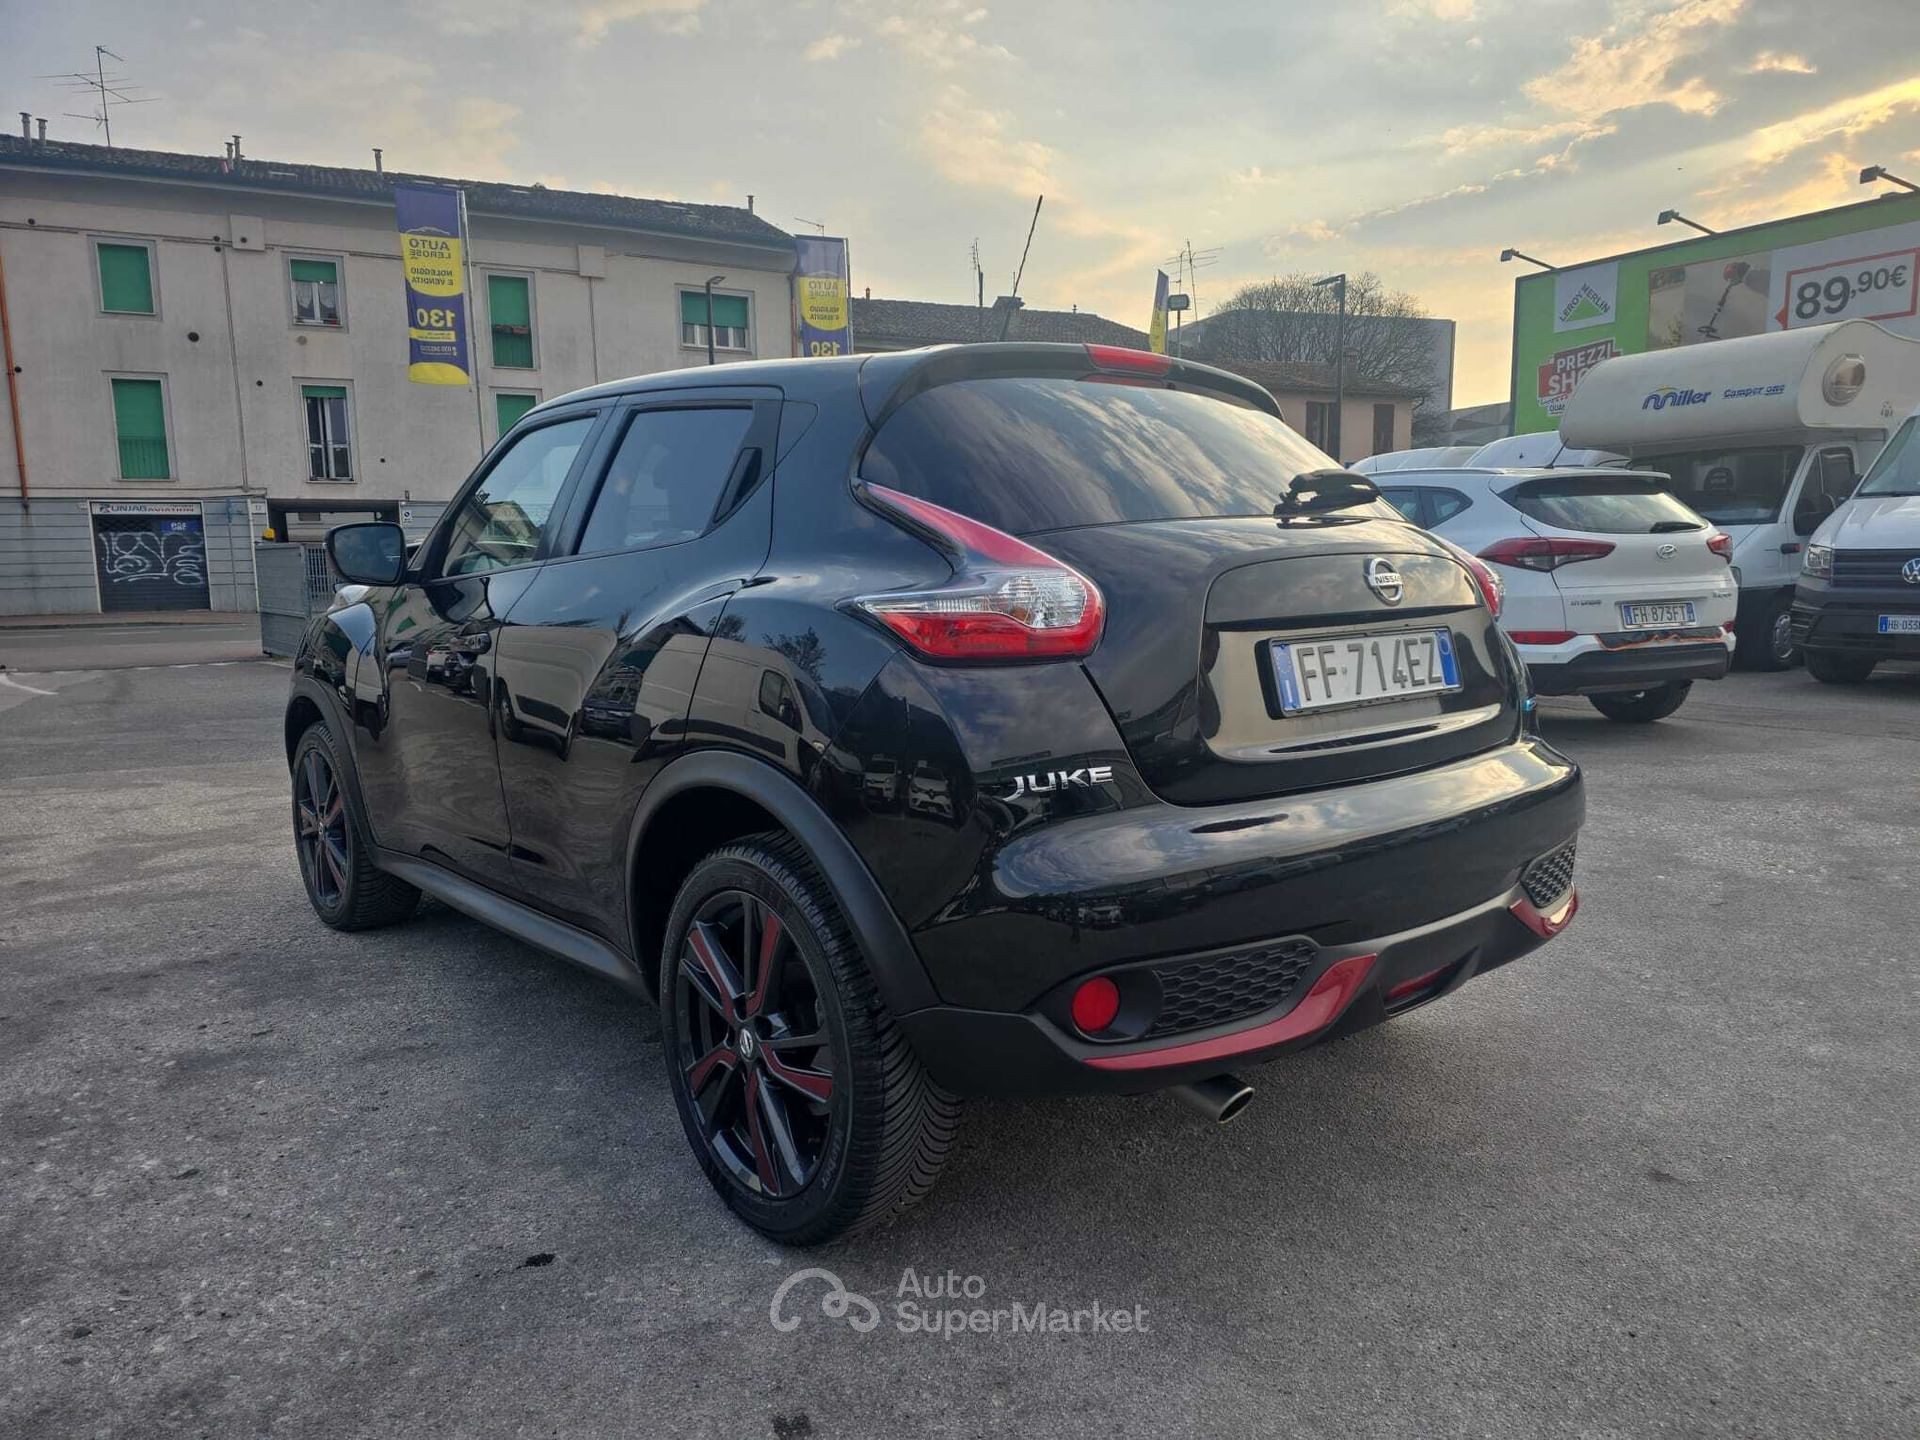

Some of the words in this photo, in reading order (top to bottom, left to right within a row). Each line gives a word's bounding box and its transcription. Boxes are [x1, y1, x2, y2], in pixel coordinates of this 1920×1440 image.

[1559, 290, 1583, 322] LEROY
[1581, 283, 1611, 314] MERLIN
[1795, 264, 1908, 320] 89,90€
[1557, 342, 1611, 373] PREZZI
[1902, 619, 1920, 631] 033
[1297, 644, 1337, 701] FF
[1347, 636, 1443, 695] 714EZ
[1002, 766, 1113, 802] JUKE
